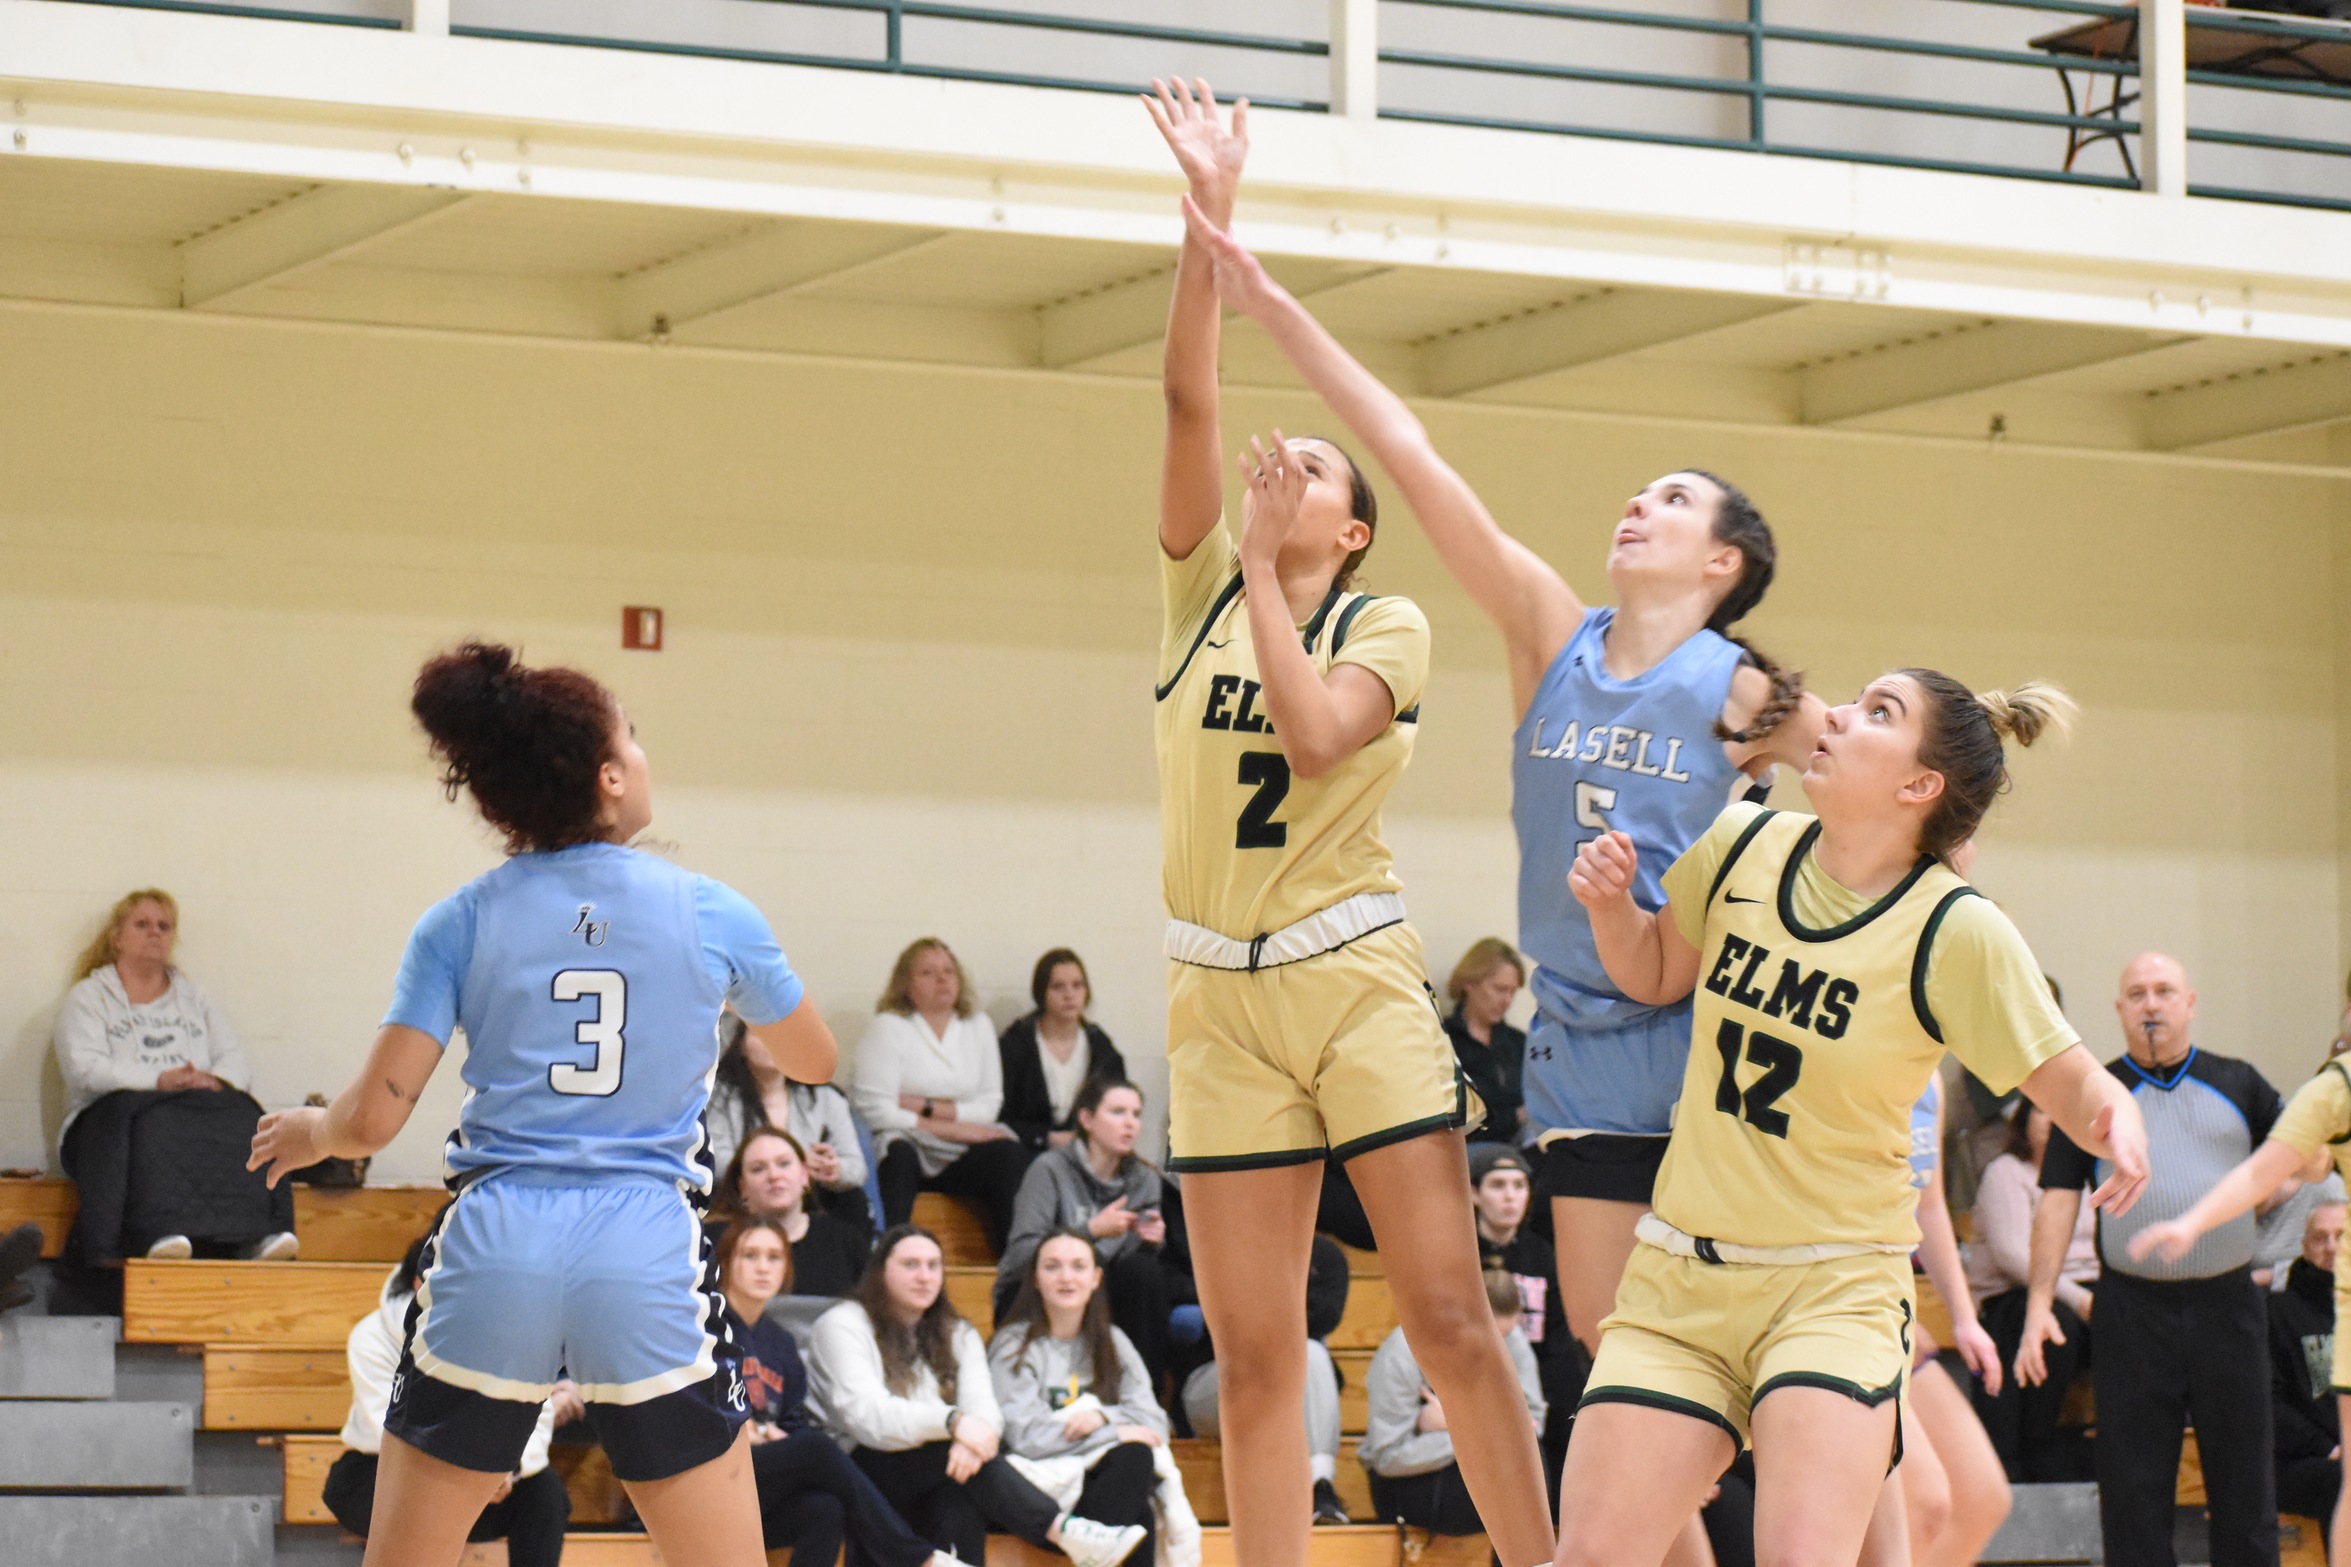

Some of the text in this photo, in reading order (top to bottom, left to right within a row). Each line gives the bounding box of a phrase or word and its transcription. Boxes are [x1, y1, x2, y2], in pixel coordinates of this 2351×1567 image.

[1201, 674, 1276, 735] EL
[1528, 716, 1691, 784] LASELL
[1235, 750, 1291, 849] 2
[1574, 780, 1618, 857] 5
[548, 968, 627, 1097] 3
[1704, 932, 1860, 1041] ELMS
[1715, 1017, 1803, 1140] 12
